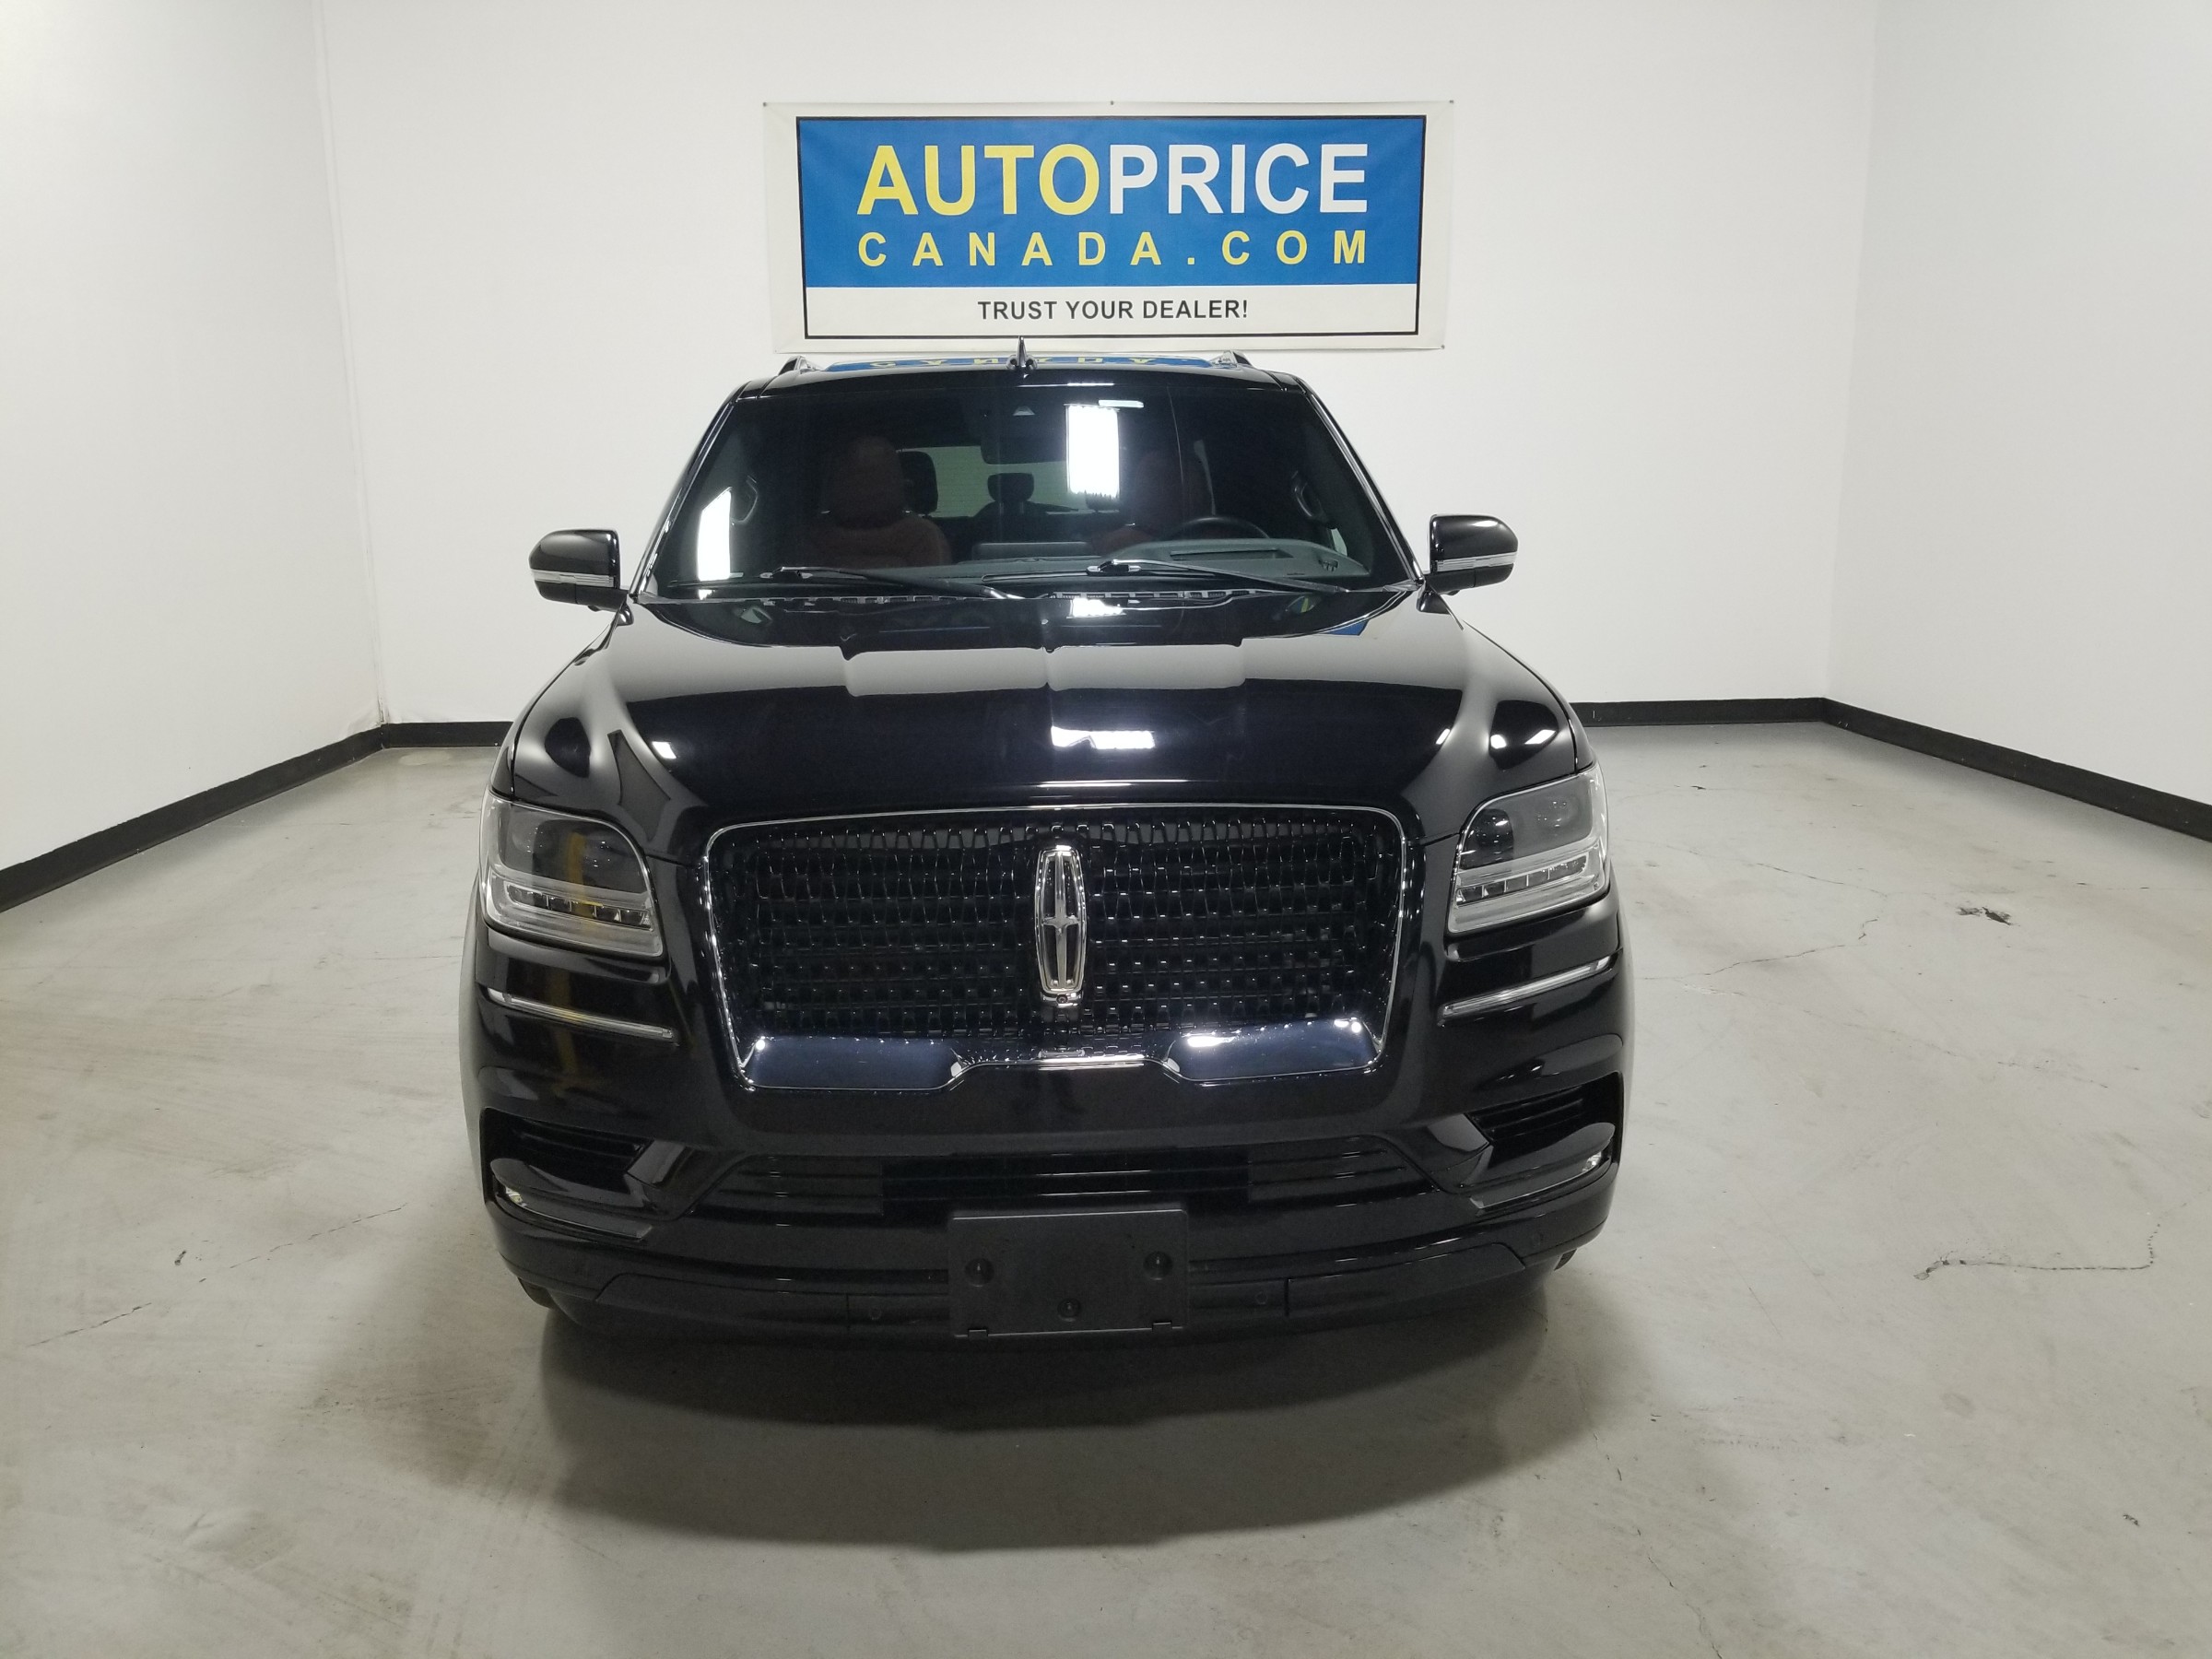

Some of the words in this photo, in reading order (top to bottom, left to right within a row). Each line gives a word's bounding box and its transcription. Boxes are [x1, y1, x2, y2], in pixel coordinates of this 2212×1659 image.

[856, 142, 1369, 216] AUTOPRICE
[858, 229, 1366, 267] CANADA.COM
[977, 300, 1057, 320] TRUST
[1065, 300, 1134, 320] YOUR
[1143, 300, 1247, 319] DEALER!
